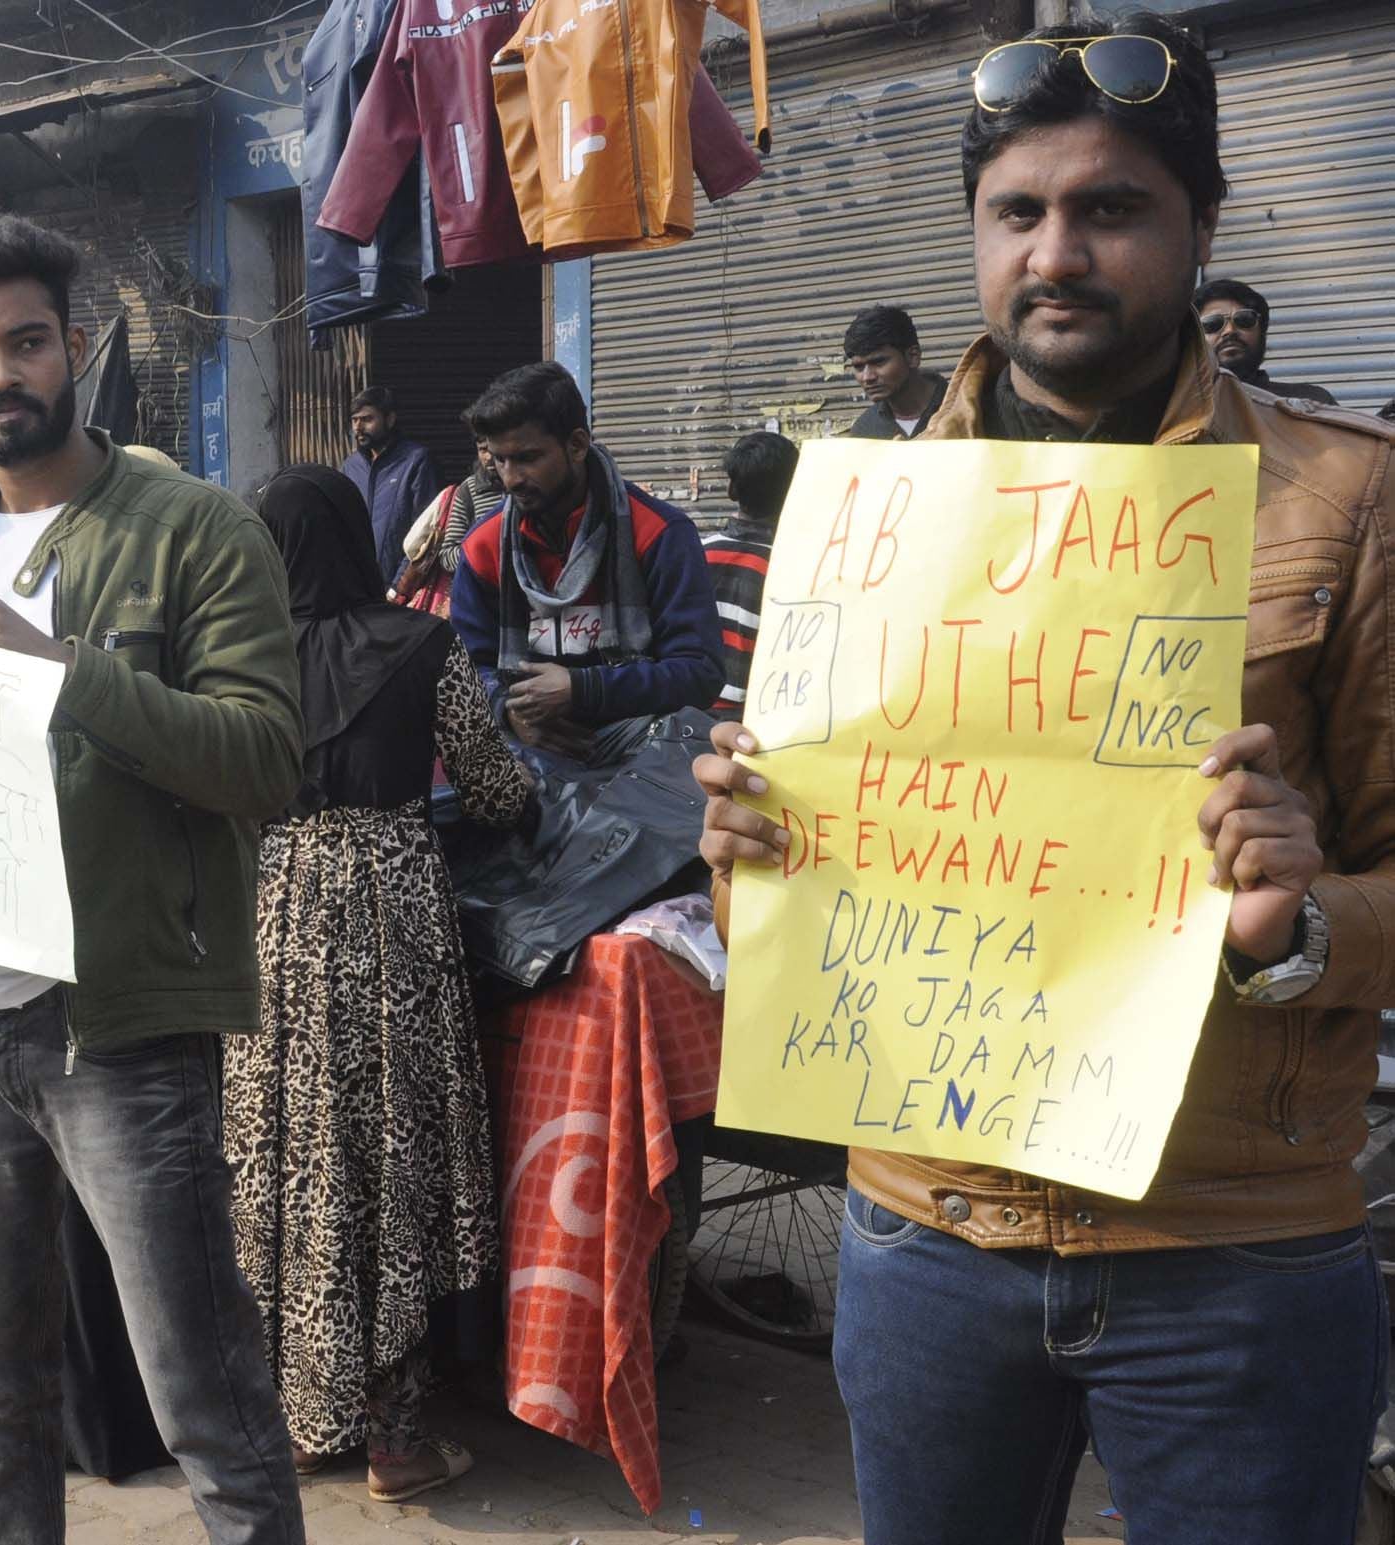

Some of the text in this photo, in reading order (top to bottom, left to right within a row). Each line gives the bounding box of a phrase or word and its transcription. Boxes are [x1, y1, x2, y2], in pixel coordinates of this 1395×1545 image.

[409, 27, 442, 36] FILA
[810, 477, 1218, 596] AB JAAG
[770, 611, 824, 658] NO
[1141, 637, 1202, 675] NO
[757, 671, 812, 713] CAB
[878, 618, 1111, 732] UTHE
[1117, 702, 1212, 749] NRC
[857, 741, 1007, 822] HAIN
[822, 889, 1037, 972] DUNIYA
[831, 970, 1048, 1027] KO JAGA
[782, 1012, 1115, 1097] KAR DAMM
